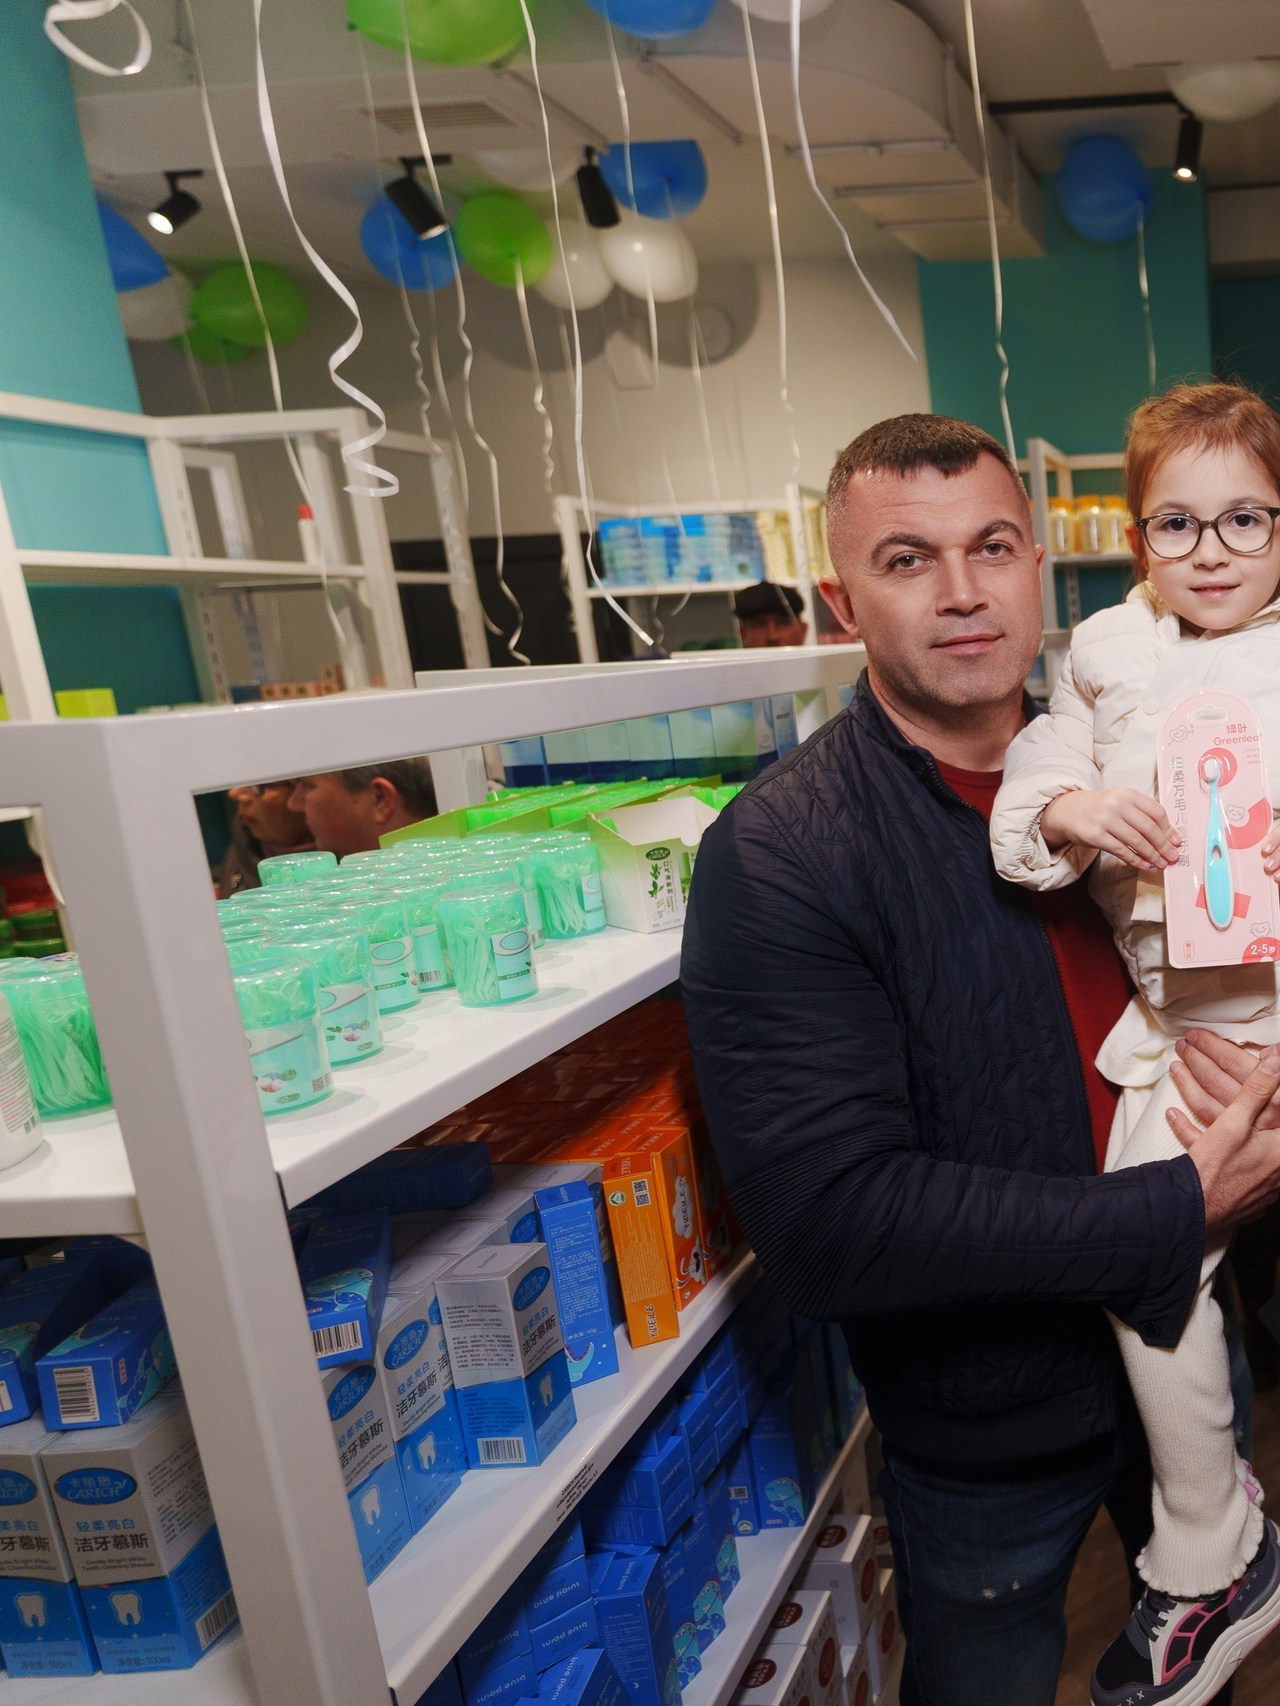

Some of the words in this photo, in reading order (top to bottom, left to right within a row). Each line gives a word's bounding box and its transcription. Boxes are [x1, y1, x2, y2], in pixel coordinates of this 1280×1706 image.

[1226, 723, 1247, 735] 绿叶
[649, 1303, 658, 1340] YIBEILE
[522, 1314, 556, 1356] 洁牙慕斯
[396, 1361, 431, 1395] 轻柔亮白
[395, 1370, 438, 1419] 洁牙慕斯
[337, 1409, 375, 1447] 轻柔亮白
[66, 1486, 120, 1499] CARICH
[76, 1518, 136, 1533] 轻柔亮白
[74, 1532, 150, 1553] 洁牙慕斯
[533, 1592, 554, 1610] blue
[555, 1581, 582, 1599] point
[567, 1620, 589, 1636] blue
[541, 1631, 567, 1649] point
[562, 1656, 579, 1677] blue
[504, 1673, 527, 1691] blue
[551, 1677, 567, 1702] point
[476, 1683, 503, 1705] point
